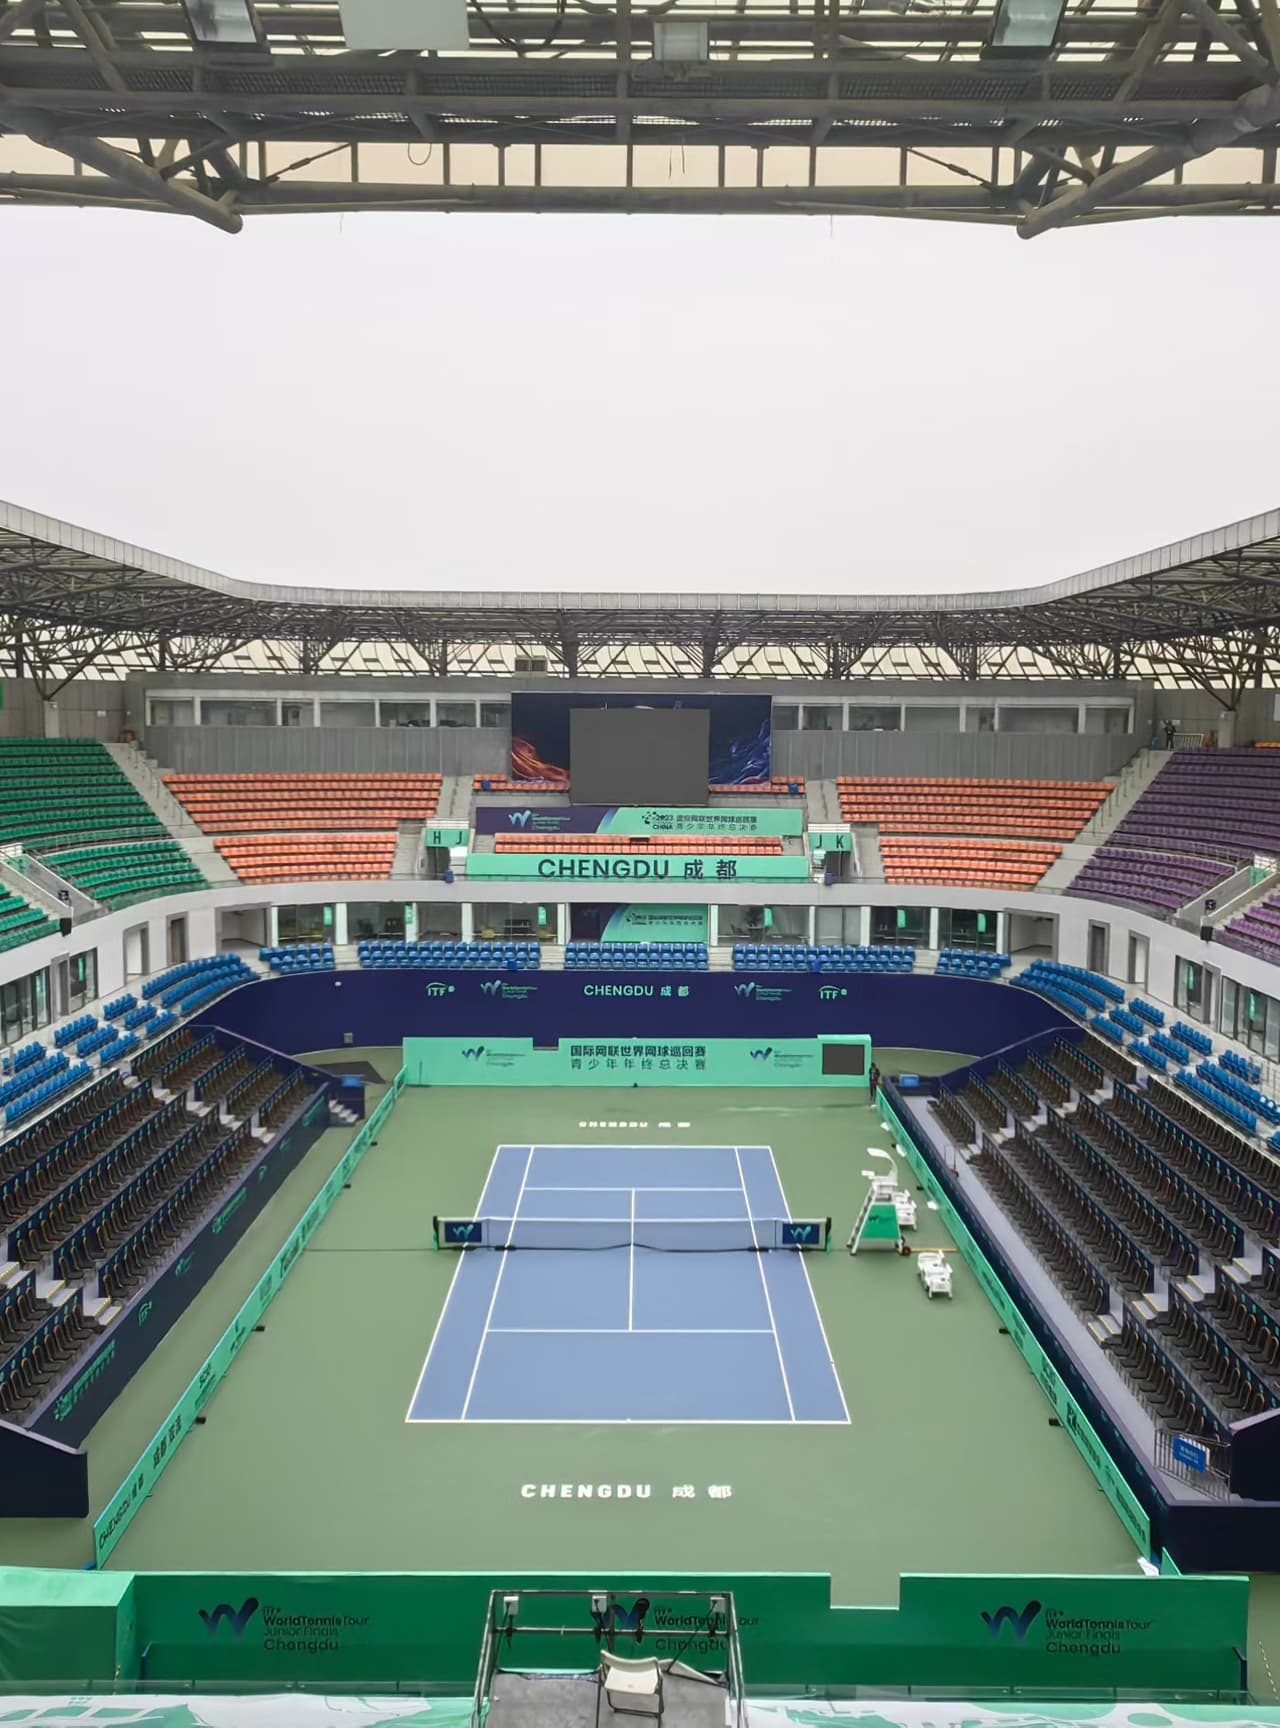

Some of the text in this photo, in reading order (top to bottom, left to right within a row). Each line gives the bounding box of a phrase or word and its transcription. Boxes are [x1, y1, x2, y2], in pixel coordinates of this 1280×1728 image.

[433, 830, 463, 845] H J
[815, 834, 844, 849] J K
[537, 859, 737, 880] CHENGDU 成都
[427, 987, 448, 997] ITF
[583, 985, 654, 997] CHENGDU
[820, 989, 840, 999] ITF
[521, 1484, 651, 1498] CHENGDU
[263, 1639, 339, 1654] Chengdu
[1045, 1641, 1121, 1656] Chengdu
